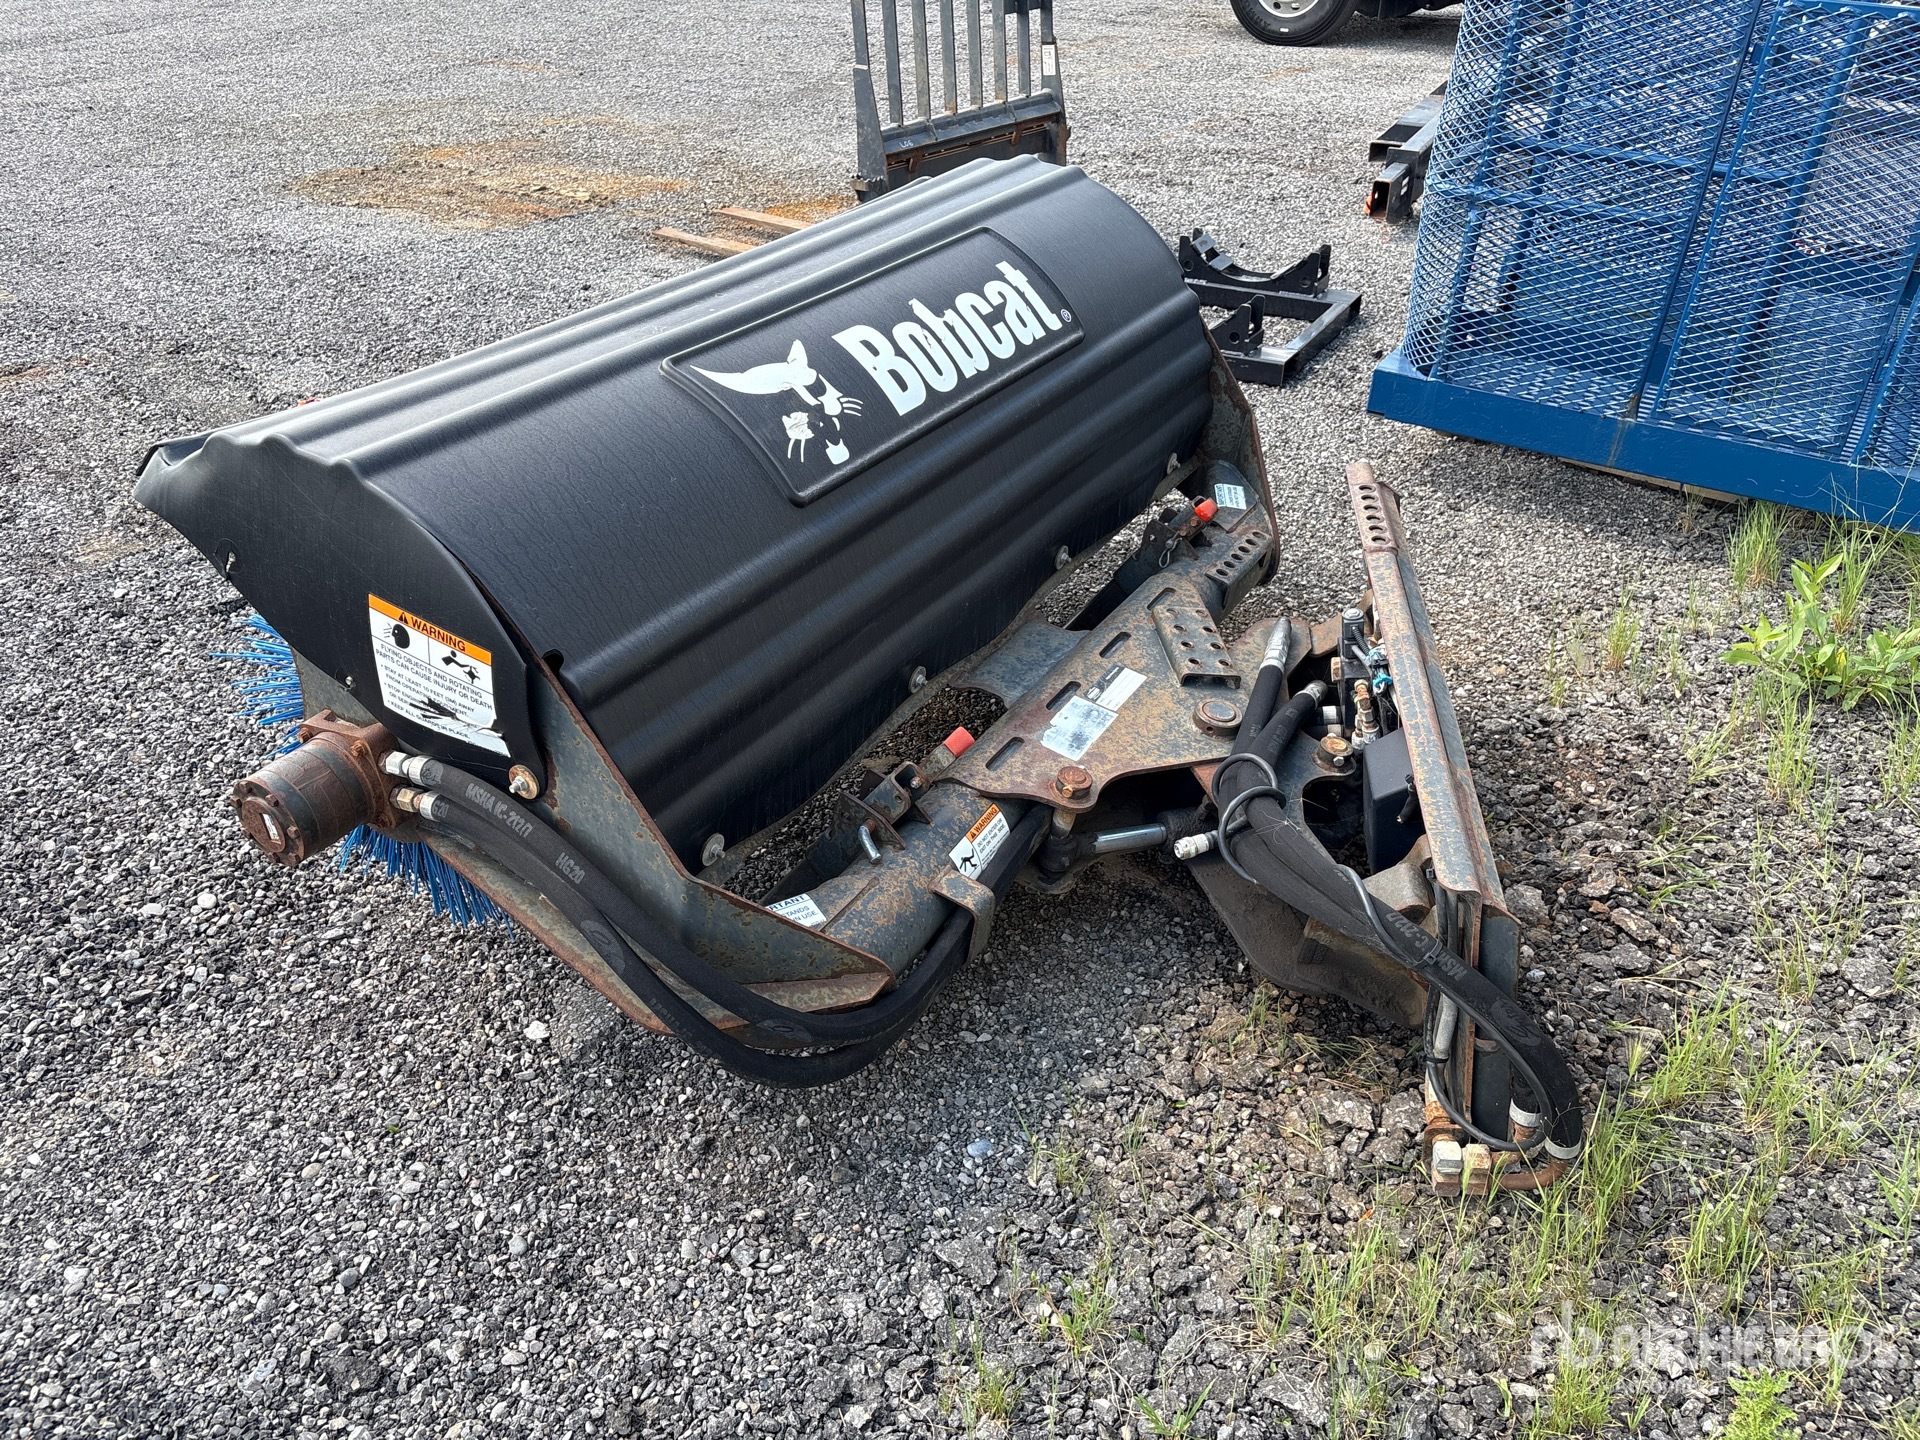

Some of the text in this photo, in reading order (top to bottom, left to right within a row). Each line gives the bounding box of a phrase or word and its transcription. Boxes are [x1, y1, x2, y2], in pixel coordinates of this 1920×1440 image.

[831, 260, 1063, 416] Bobcat
[411, 616, 466, 652] WARNING
[375, 648, 493, 711] PARTS CAN CAUSE INJURY OR DEATH
[380, 643, 482, 699] FLYING OBJECTS AND ROTATING
[431, 800, 449, 818] G20
[973, 807, 998, 833] WARNING
[465, 782, 495, 812] MSHA
[555, 852, 586, 885] HG20
[768, 895, 806, 911] RTANT
